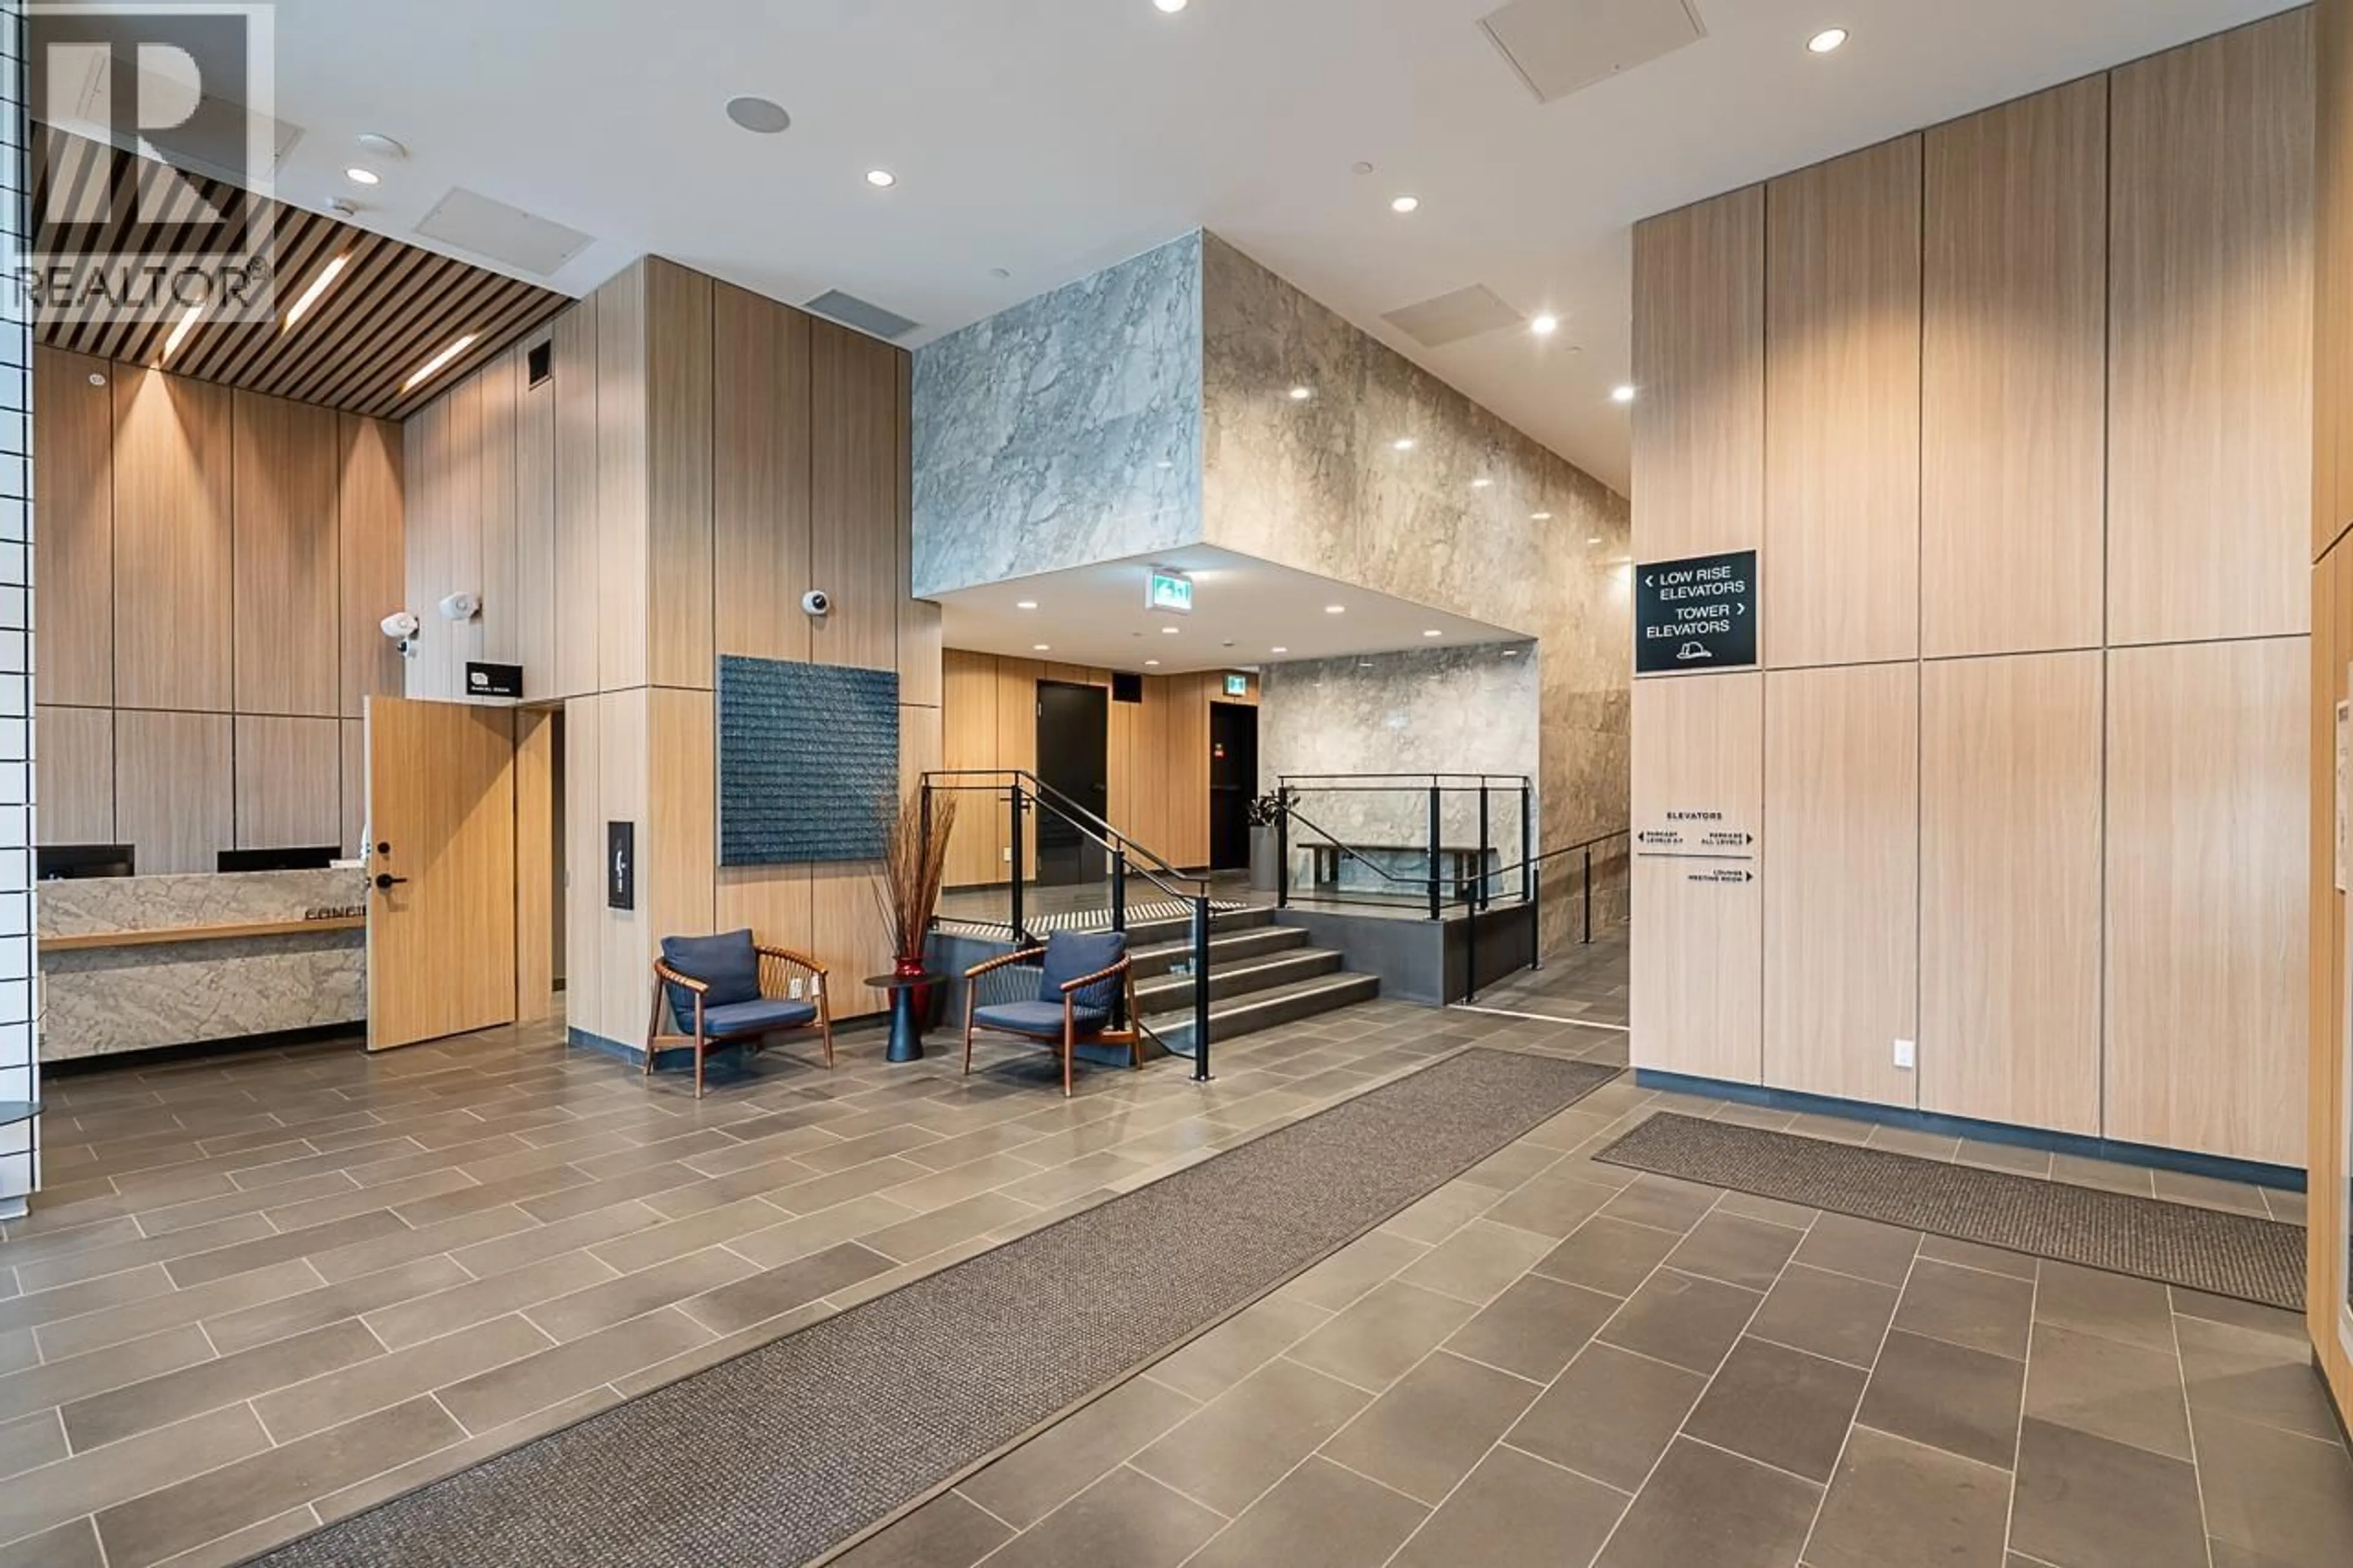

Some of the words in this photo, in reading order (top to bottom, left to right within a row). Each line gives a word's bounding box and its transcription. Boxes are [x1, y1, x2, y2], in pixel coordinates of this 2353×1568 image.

[1660, 571, 1692, 586] LOW
[1696, 566, 1732, 581] RISE
[1660, 580, 1746, 600] ELEVATORS
[1675, 604, 1730, 621] TOWER
[1646, 619, 1730, 638] ELEVATORS
[1667, 812, 1722, 820] ELEVATORS
